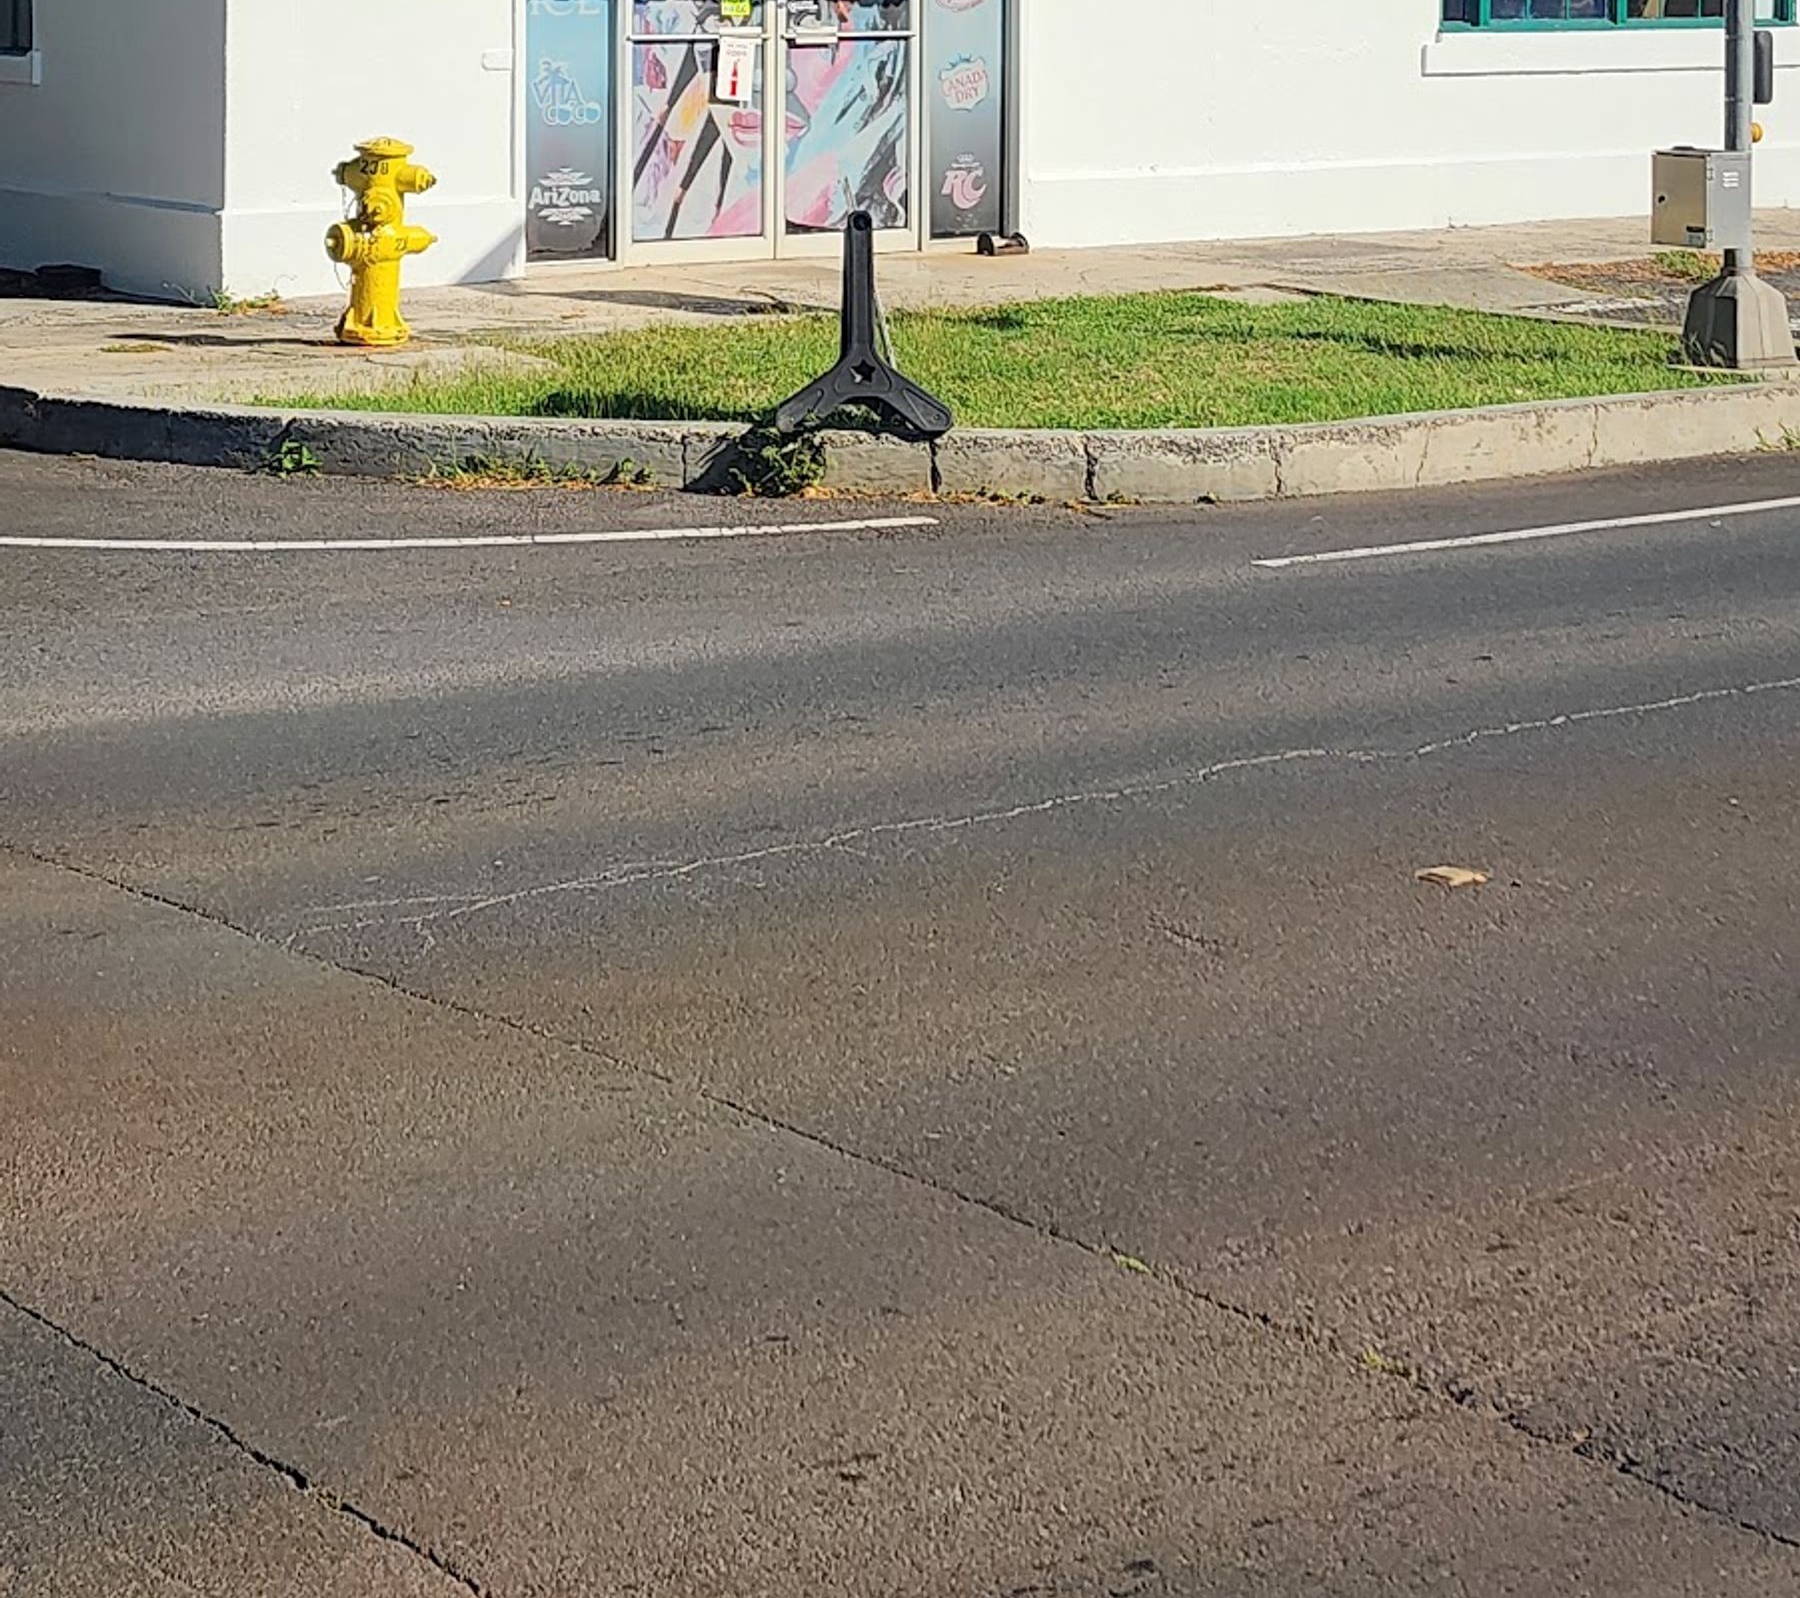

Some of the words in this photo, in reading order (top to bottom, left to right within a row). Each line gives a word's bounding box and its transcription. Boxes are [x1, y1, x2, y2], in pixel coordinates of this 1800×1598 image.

[955, 86, 980, 104] DRY
[542, 102, 601, 126] COCO
[528, 185, 602, 210] AriZona
[941, 166, 987, 210] RC
